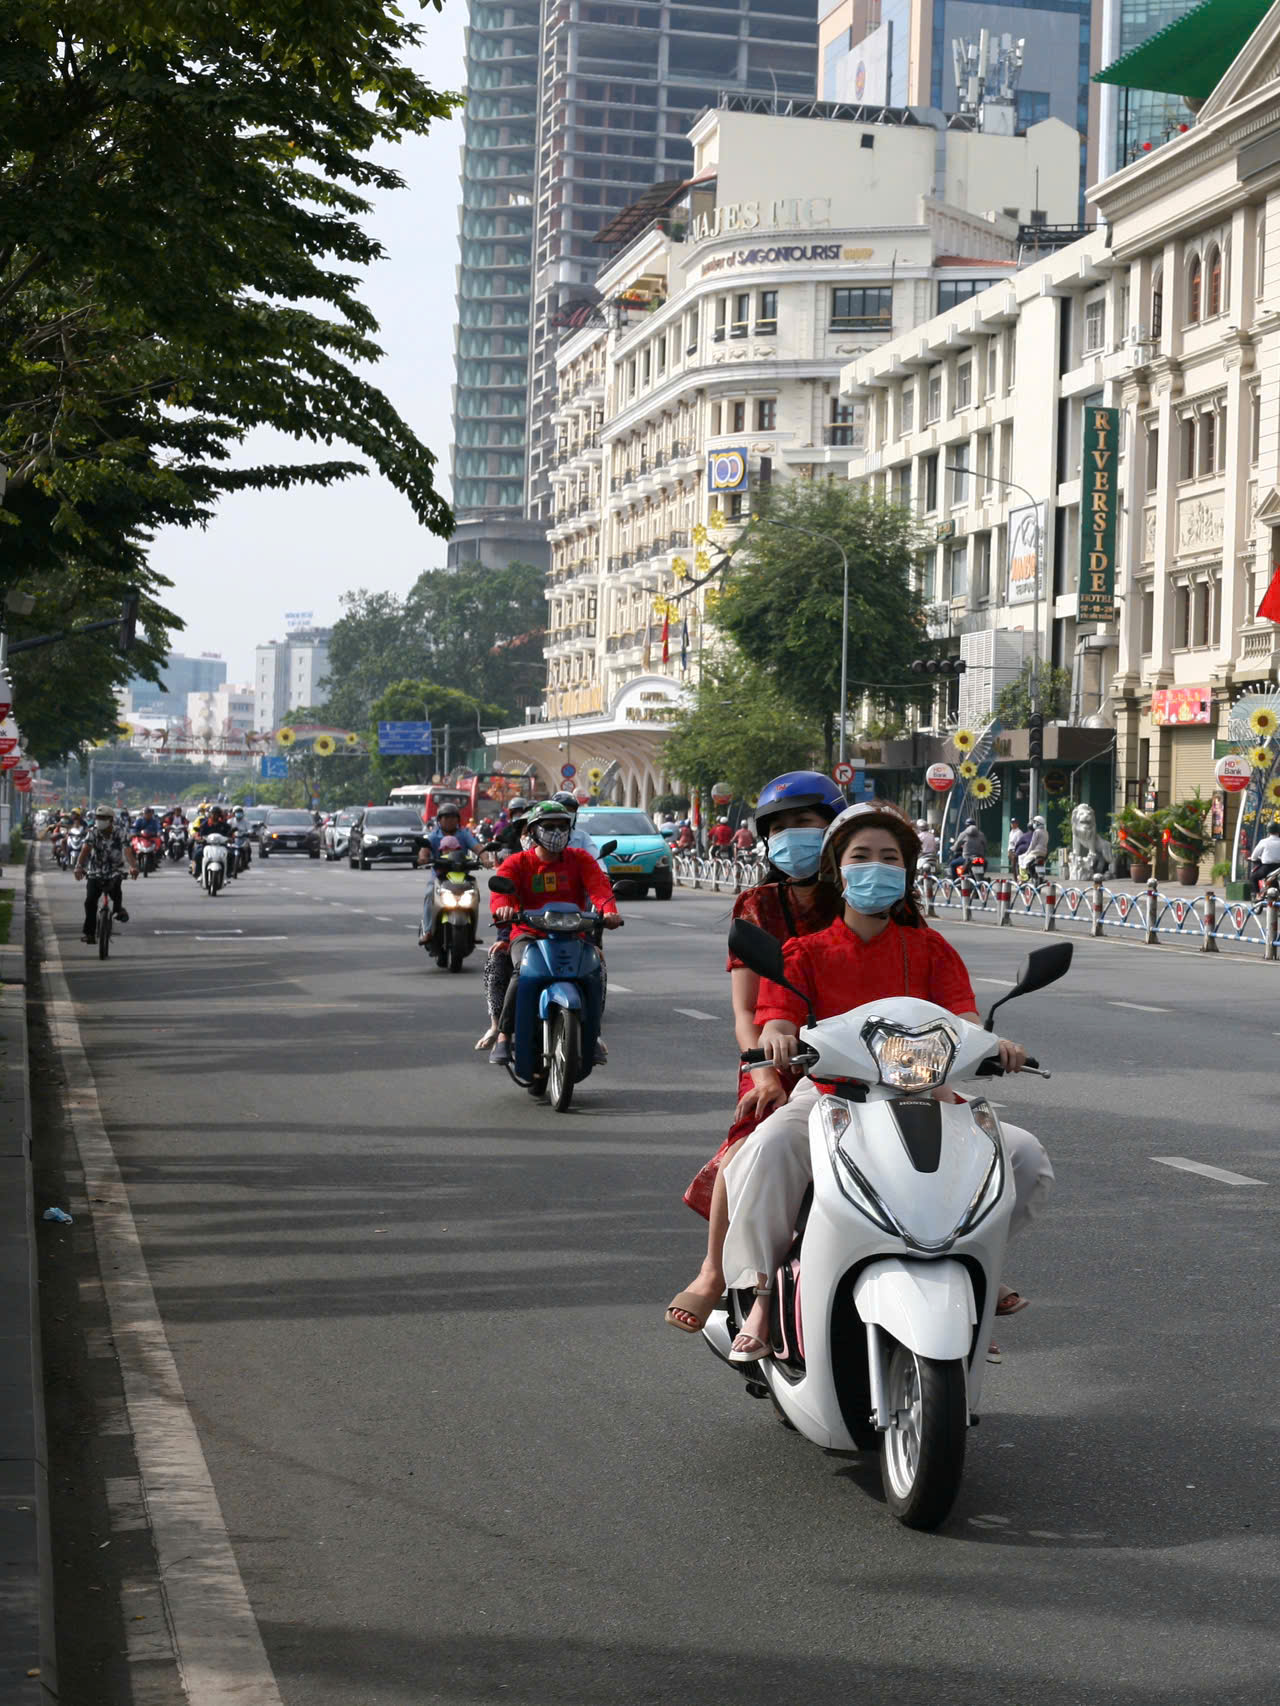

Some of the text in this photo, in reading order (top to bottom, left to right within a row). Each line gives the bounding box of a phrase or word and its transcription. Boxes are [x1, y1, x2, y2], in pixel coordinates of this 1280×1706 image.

[737, 244, 842, 266] SAIGONTOURIST
[1090, 410, 1112, 593] RIVERSIDE
[1224, 767, 1242, 775] Bank
